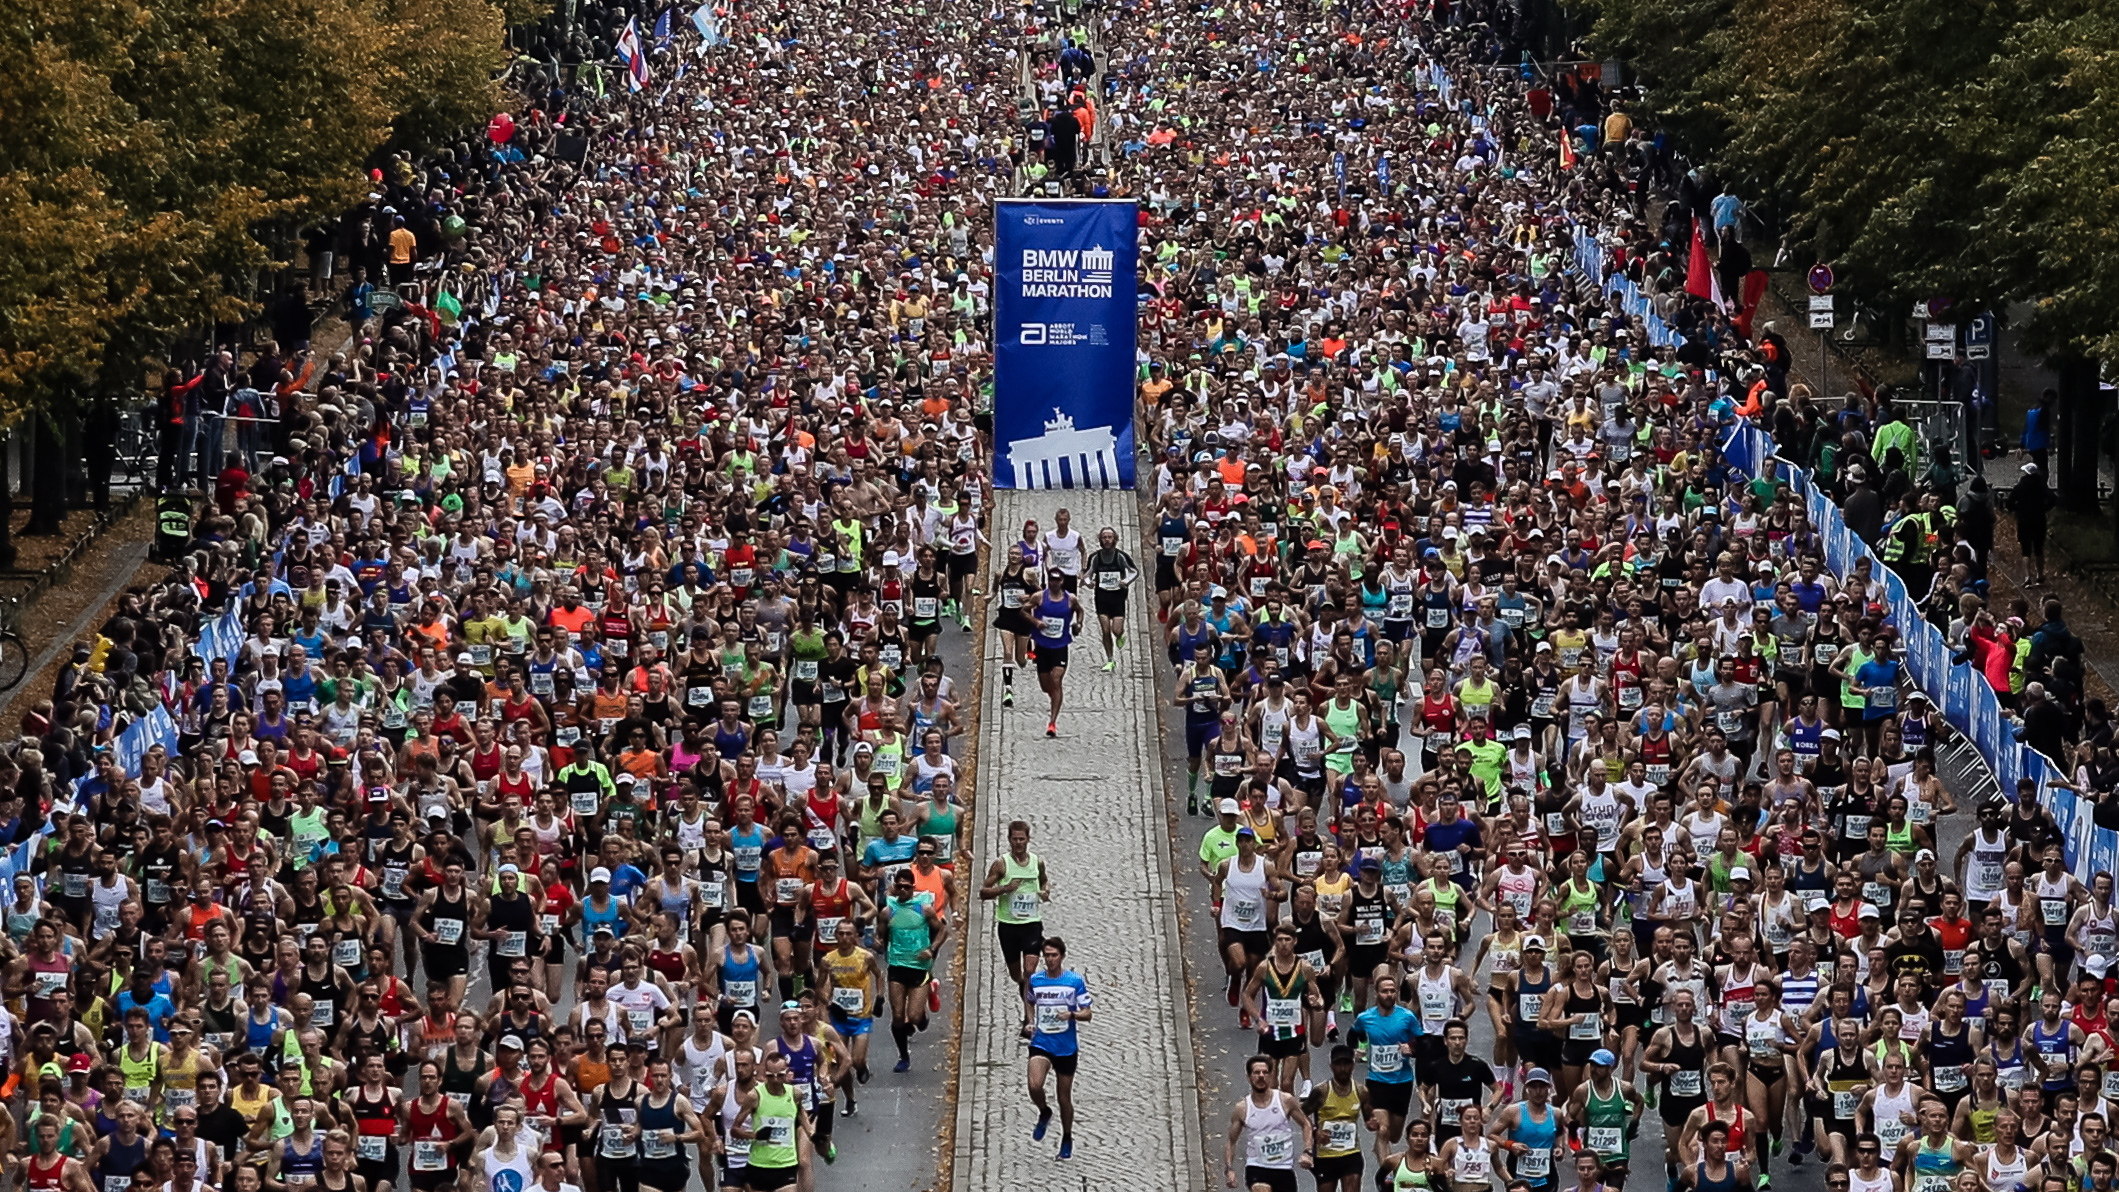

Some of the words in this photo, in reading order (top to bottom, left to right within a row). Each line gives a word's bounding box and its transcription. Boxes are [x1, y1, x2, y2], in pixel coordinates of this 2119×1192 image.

[1023, 249, 1079, 268] BMW
[1022, 269, 1078, 282] BERLIN
[1022, 284, 1112, 298] MARATHON
